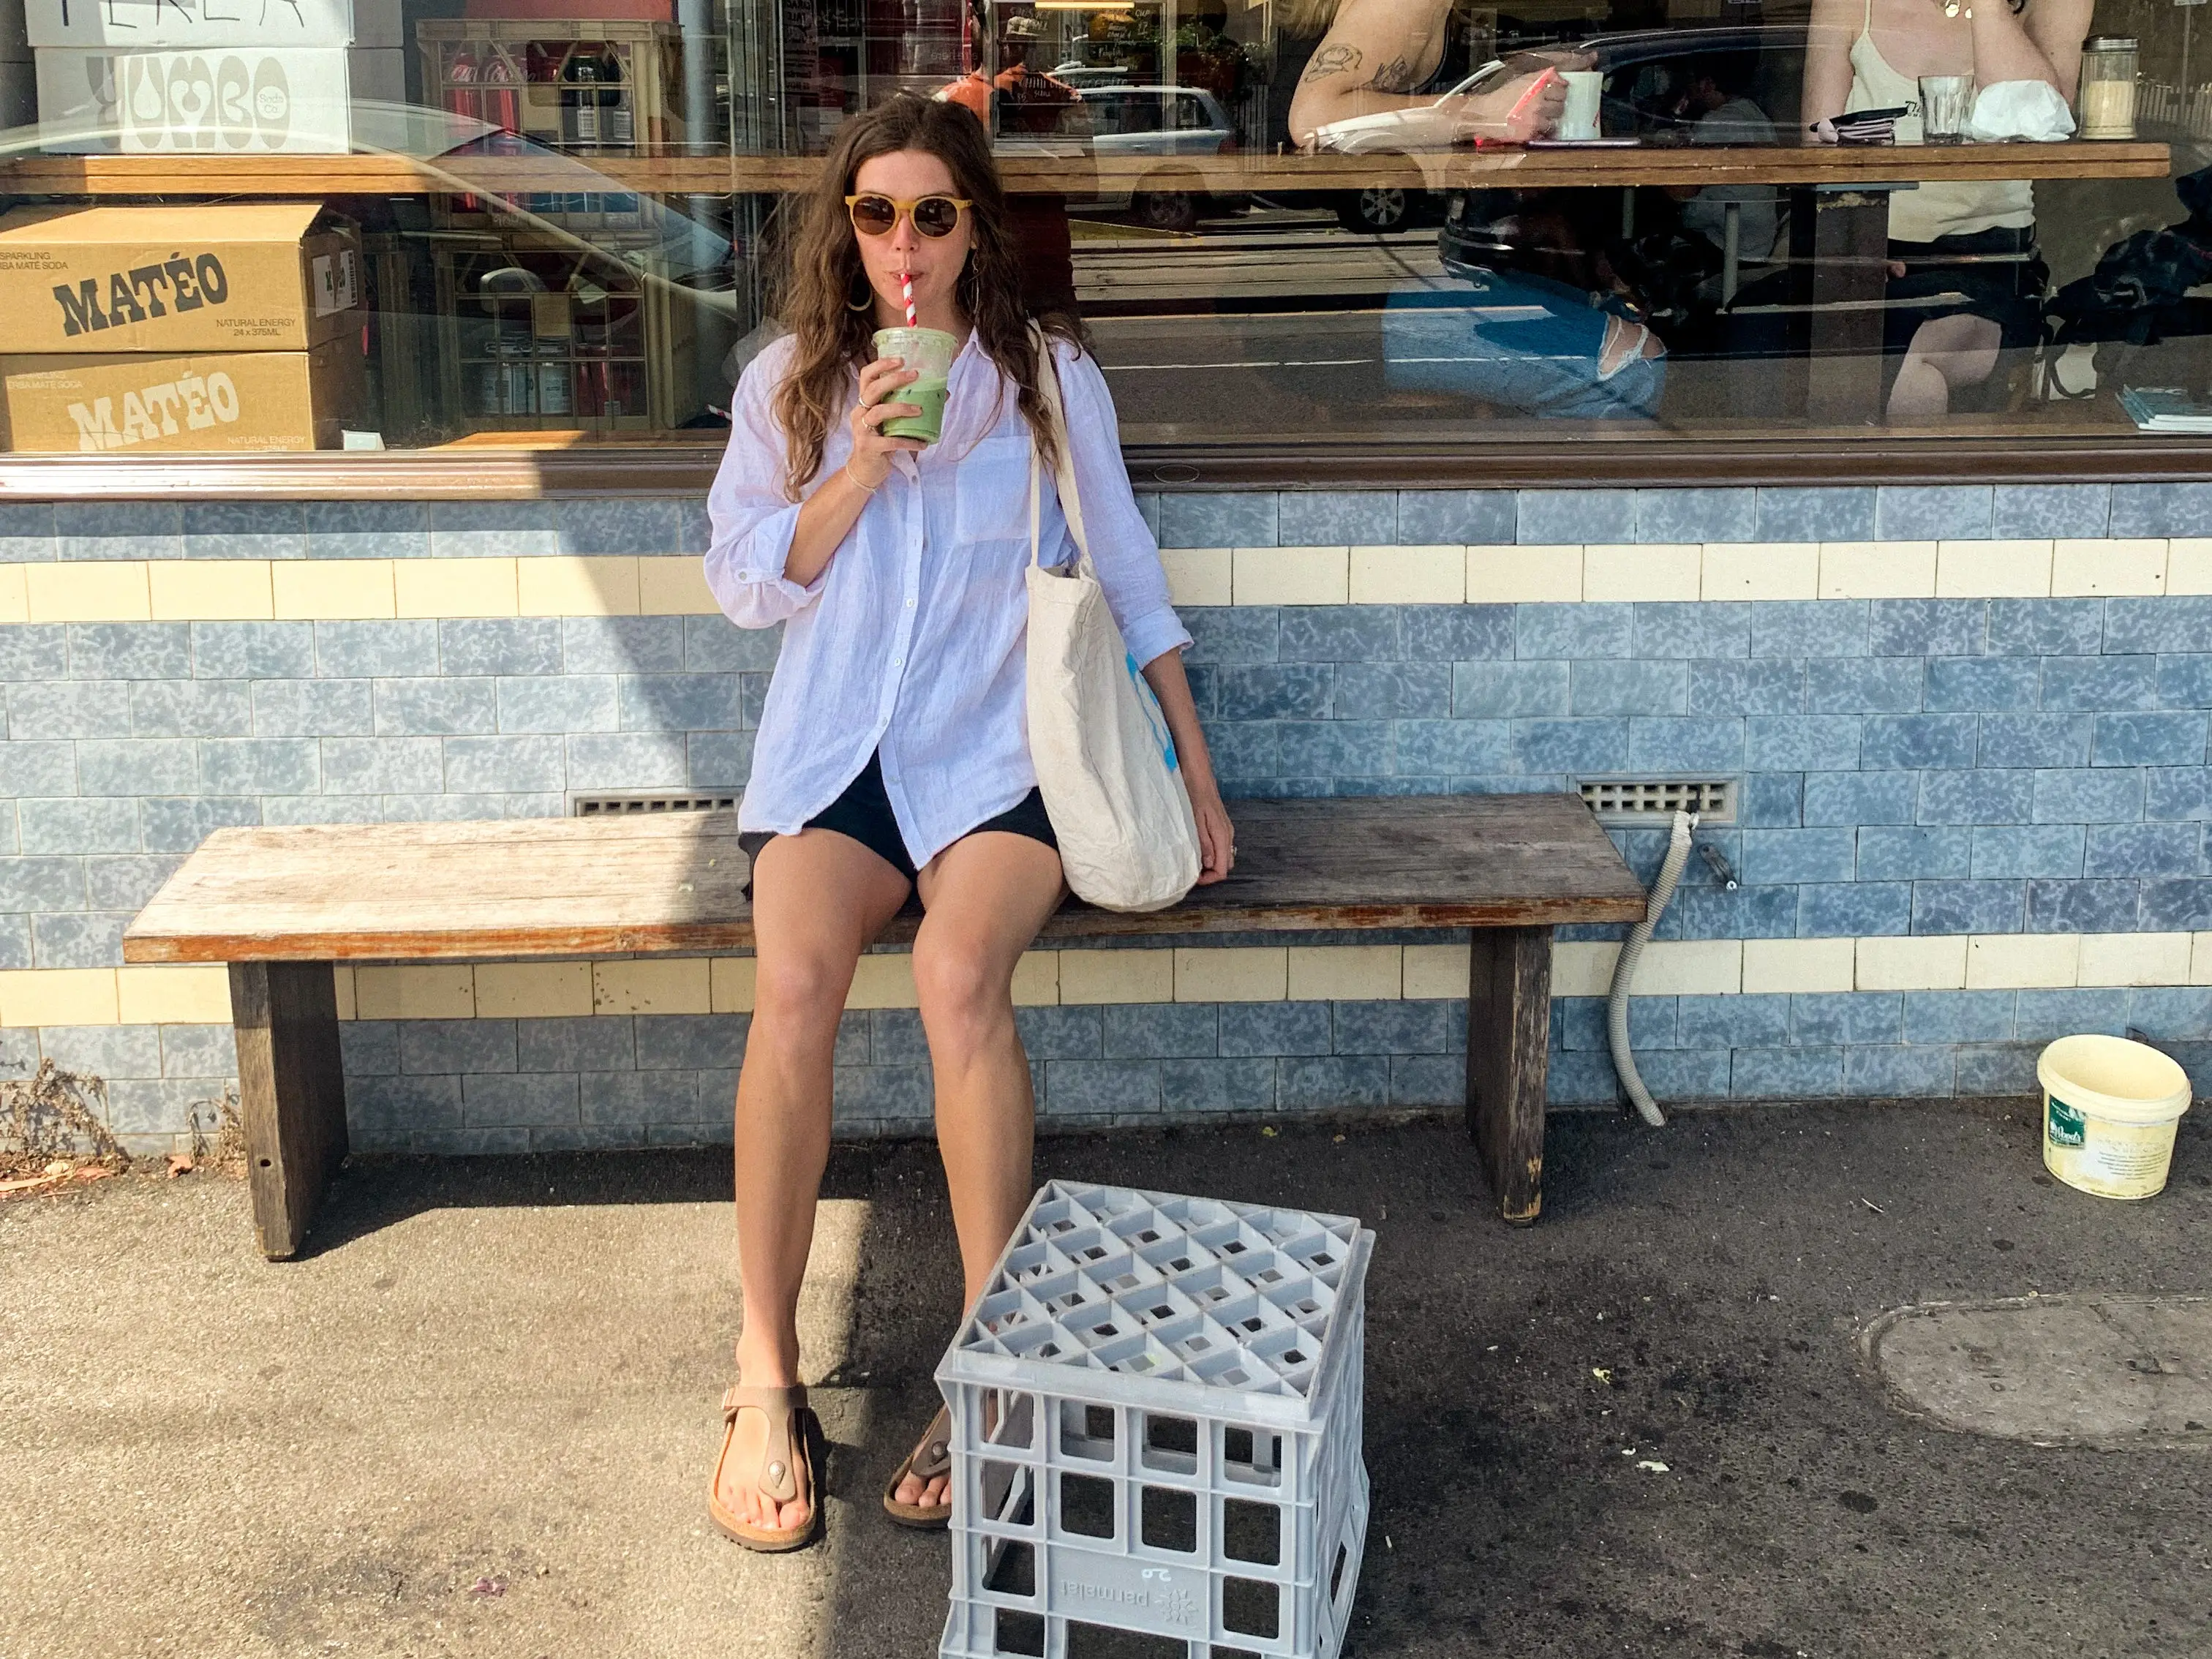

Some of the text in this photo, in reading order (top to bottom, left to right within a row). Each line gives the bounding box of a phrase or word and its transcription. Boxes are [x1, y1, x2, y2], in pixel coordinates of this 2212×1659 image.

[0, 252, 50, 260] SPARKLING
[42, 261, 69, 270] SODA
[53, 252, 228, 337] MATÉO
[217, 318, 296, 328] NATURAL ENERGY
[252, 328, 281, 336] 375ML
[67, 371, 239, 451] MATÉO
[227, 436, 306, 444] NATURAL ENERGY
[1061, 1580, 1149, 1607] parmalat
